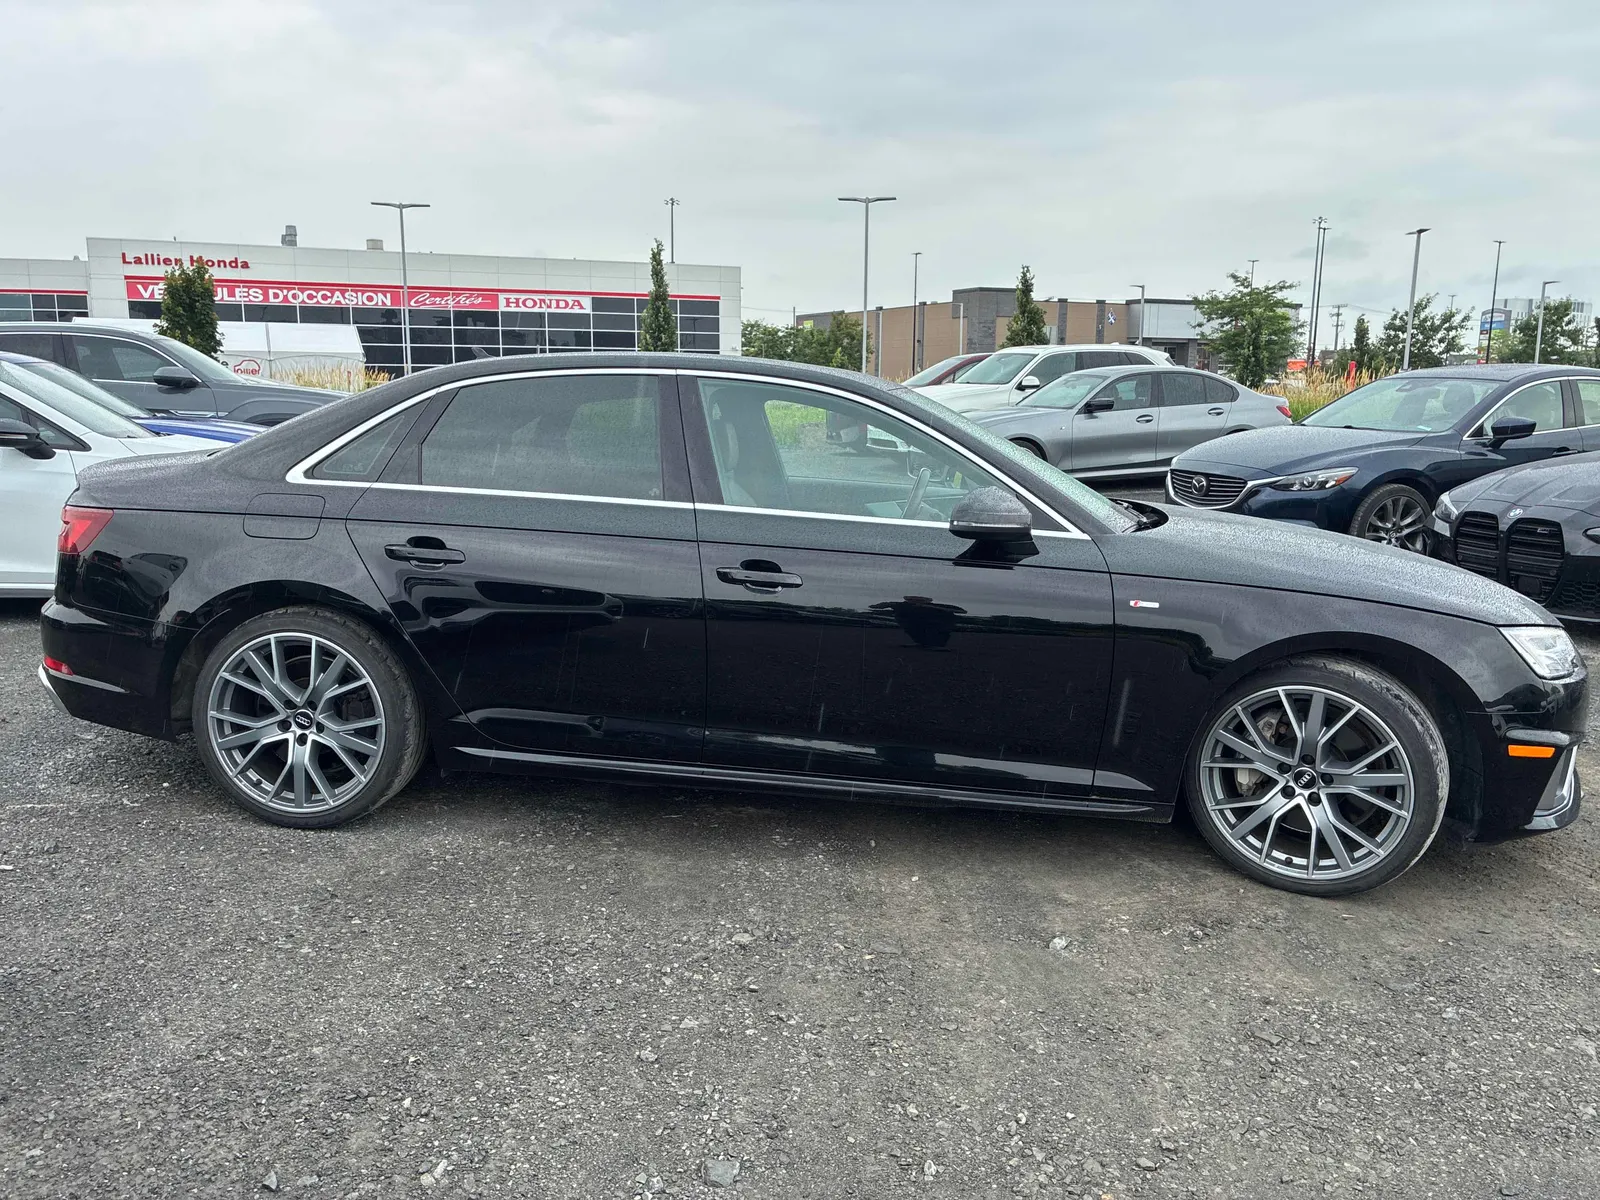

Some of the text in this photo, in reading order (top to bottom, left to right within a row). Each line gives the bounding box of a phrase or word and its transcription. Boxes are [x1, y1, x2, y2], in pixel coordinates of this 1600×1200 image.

[121, 252, 250, 269] Lallier Honda
[137, 282, 586, 310] VÉLES D'OCCASION Certifiés HONDA
